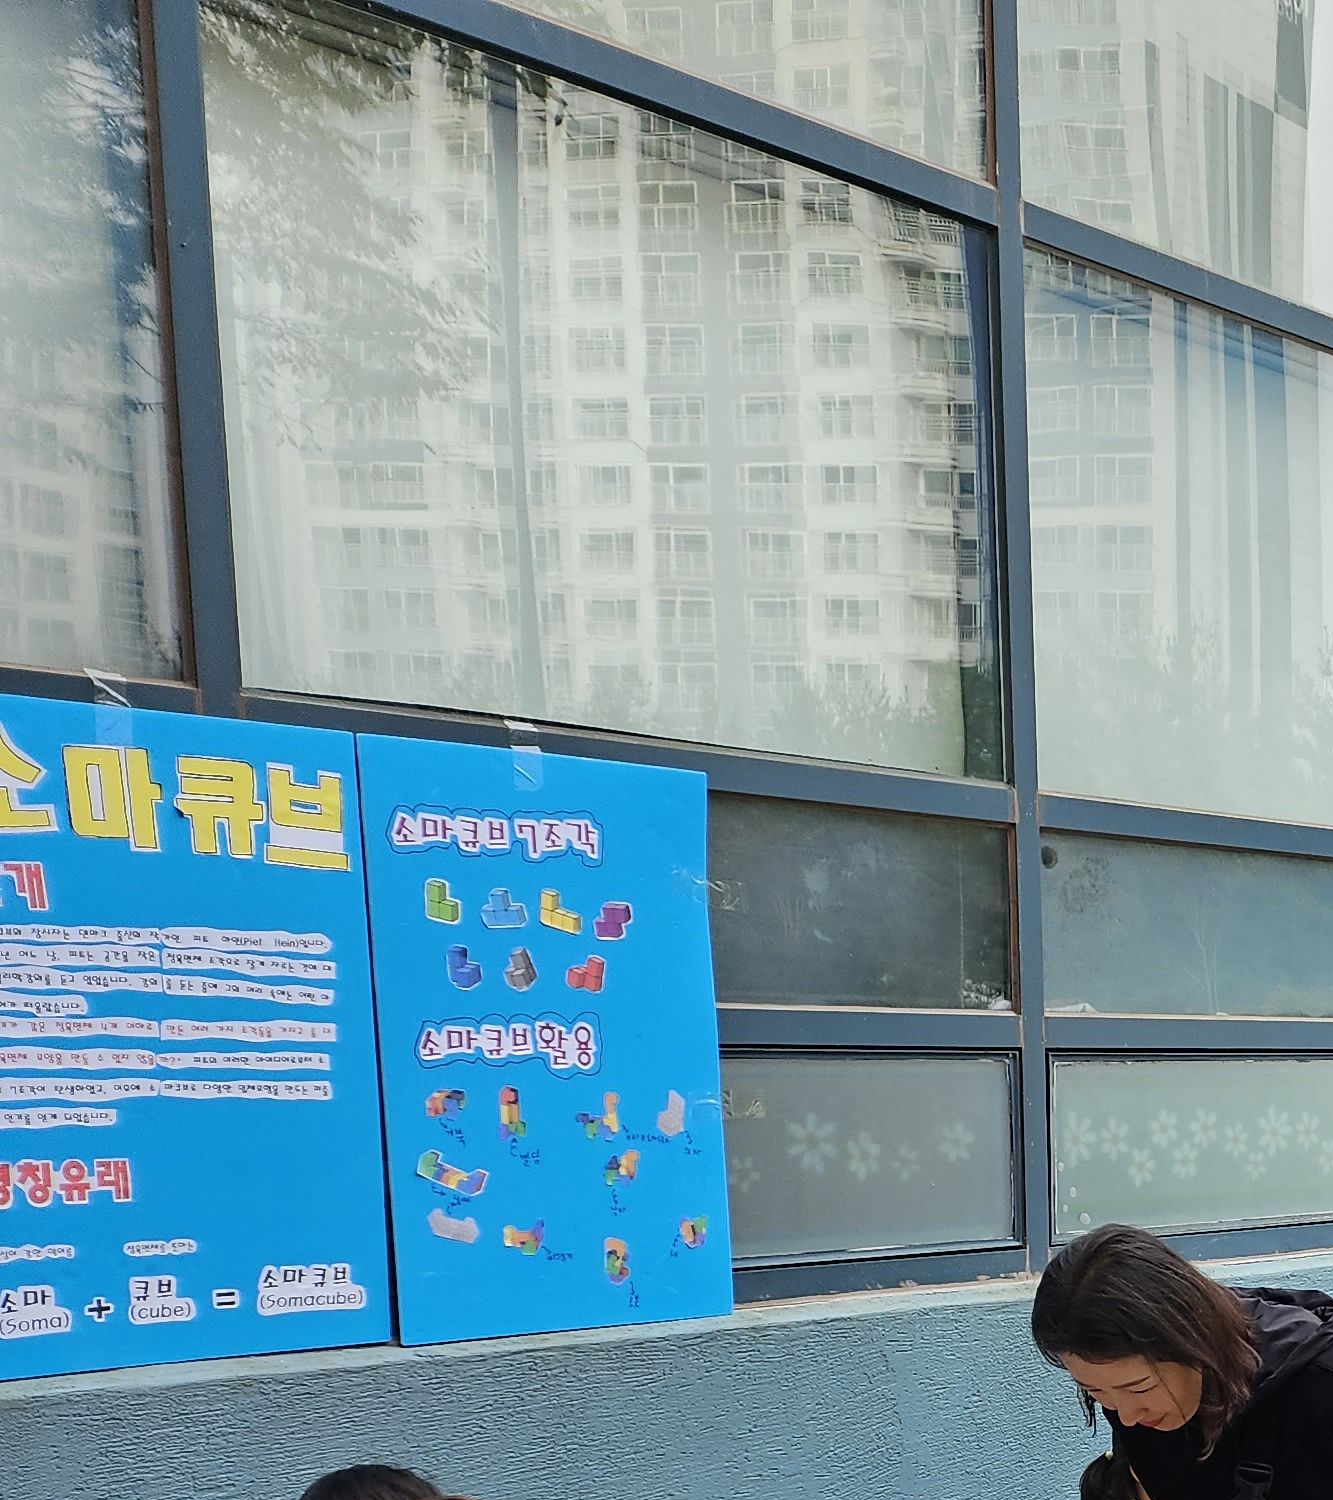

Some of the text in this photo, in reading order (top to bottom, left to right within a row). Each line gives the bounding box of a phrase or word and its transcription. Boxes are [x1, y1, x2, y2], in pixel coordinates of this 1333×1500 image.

[262, 1266, 349, 1289] 소마큐브
[1, 1289, 52, 1315] 소마
[133, 1279, 173, 1302] 큐브
[259, 1289, 365, 1311] (Somacube)
[130, 1301, 192, 1322] (cube)
